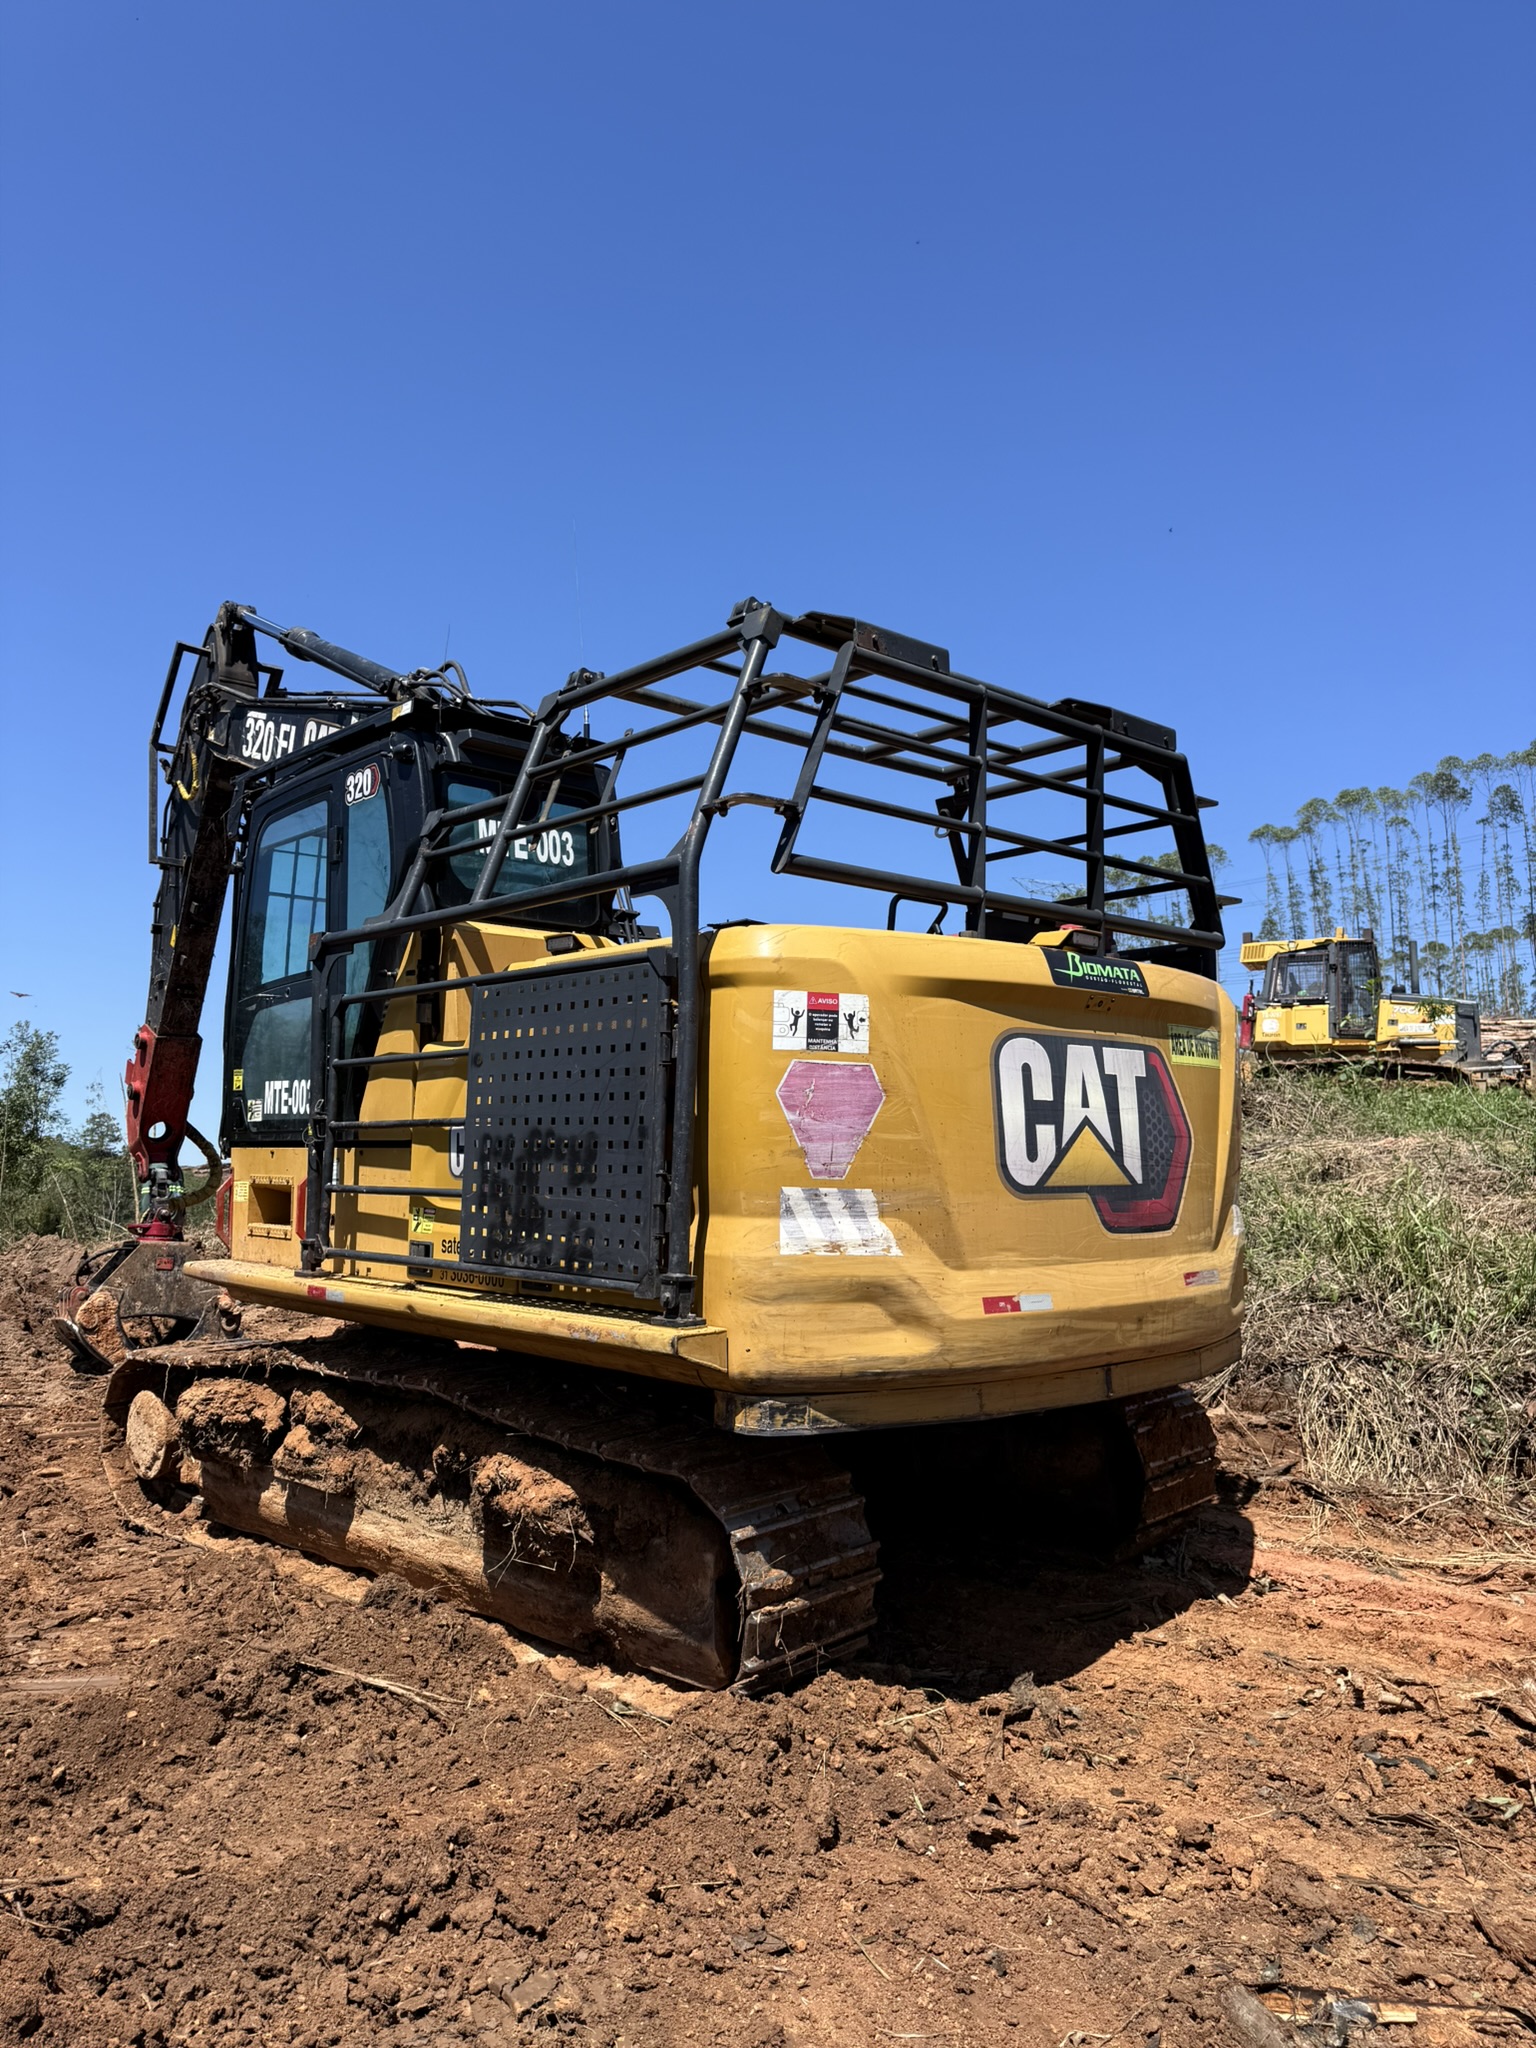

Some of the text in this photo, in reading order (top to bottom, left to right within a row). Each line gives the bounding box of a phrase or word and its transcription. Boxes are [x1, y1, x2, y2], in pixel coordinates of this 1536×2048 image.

[242, 717, 275, 762] 320
[347, 768, 372, 802] 320
[478, 818, 575, 867] ME-003
[998, 1037, 1147, 1186] CAT
